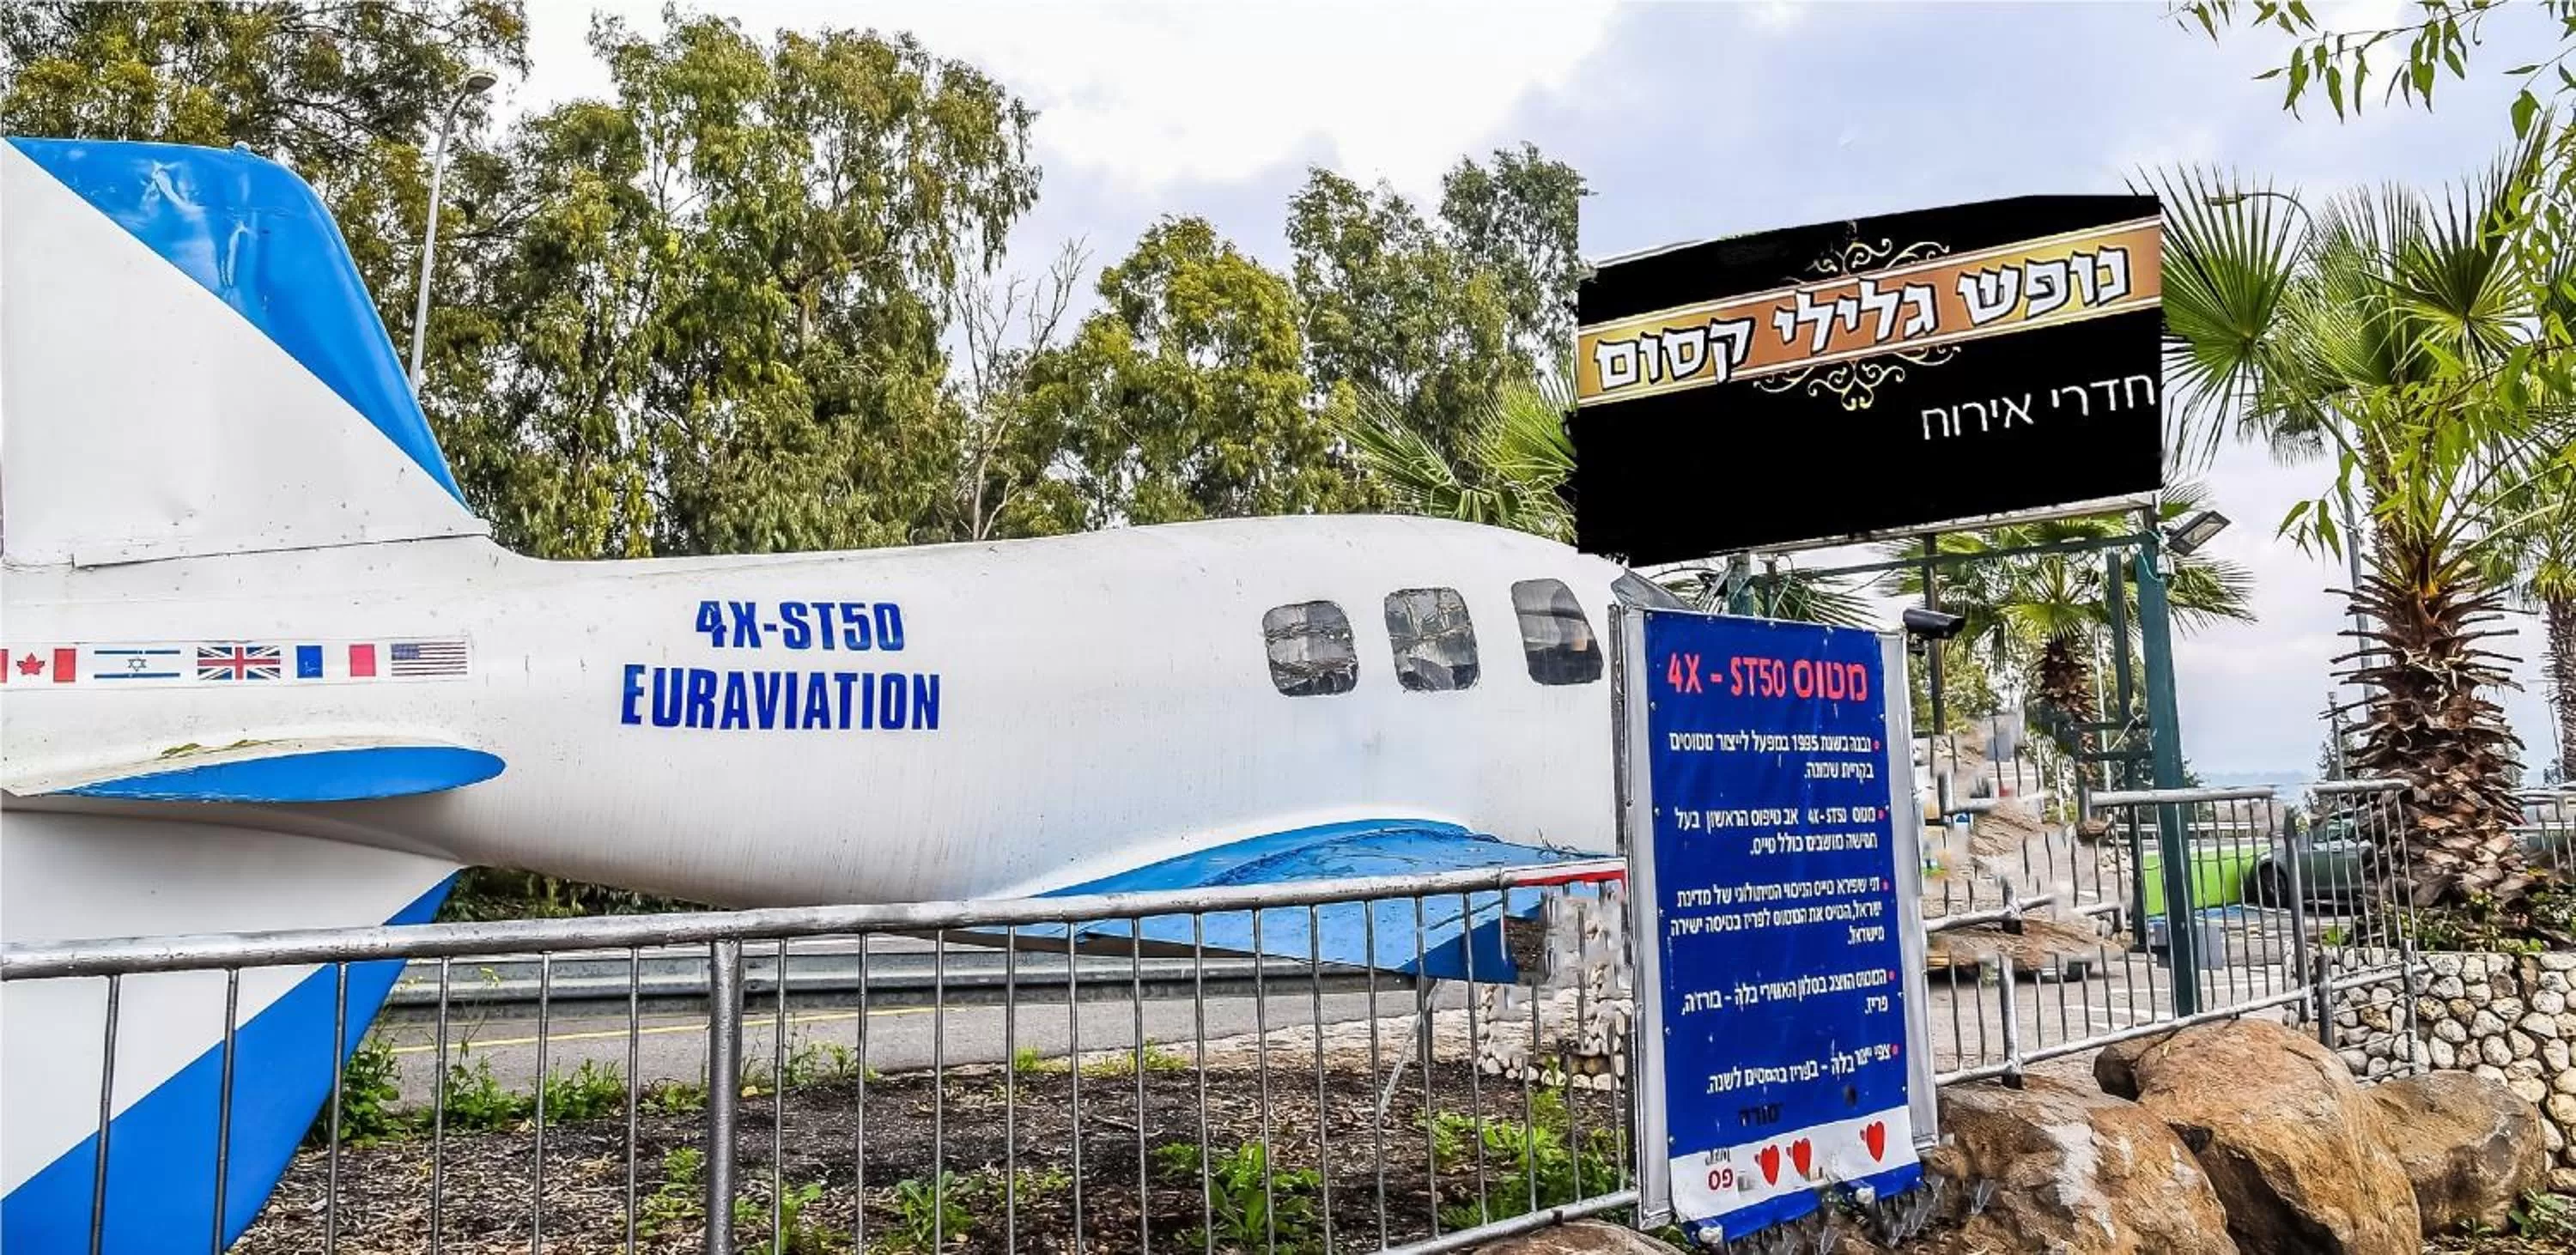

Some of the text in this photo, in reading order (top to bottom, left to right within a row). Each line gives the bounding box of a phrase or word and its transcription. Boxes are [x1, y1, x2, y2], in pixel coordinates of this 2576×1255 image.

[1595, 246, 2129, 389] נופש גלילי קסום
[1921, 374, 2155, 440] חדרי אירוח
[696, 600, 906, 652] 4X-ST50
[1668, 652, 1703, 694] 4X
[1730, 656, 1785, 697] ST50
[1793, 658, 1868, 701] מטוס
[622, 664, 940, 730] EURAVIATION
[1668, 732, 1713, 751] מטוסים
[1716, 729, 1749, 752] לייצור
[1751, 729, 1789, 754] במפעל
[1820, 735, 1850, 753] בשנת
[1674, 806, 1701, 832] בעל
[1705, 809, 1749, 835] הראשון
[1751, 809, 1782, 827] טיפוס
[1783, 808, 1799, 825] אב
[1777, 832, 1804, 854] כולל
[1805, 834, 1844, 852] מושבים
[1677, 888, 1711, 907] מדינת
[1712, 883, 1732, 905] של
[1704, 914, 1741, 933] בטיסה
[1742, 907, 1771, 929] לפריז
[1807, 906, 1824, 923] את
[1670, 918, 1703, 937] ישירה
[1797, 974, 1828, 1003] בסלון
